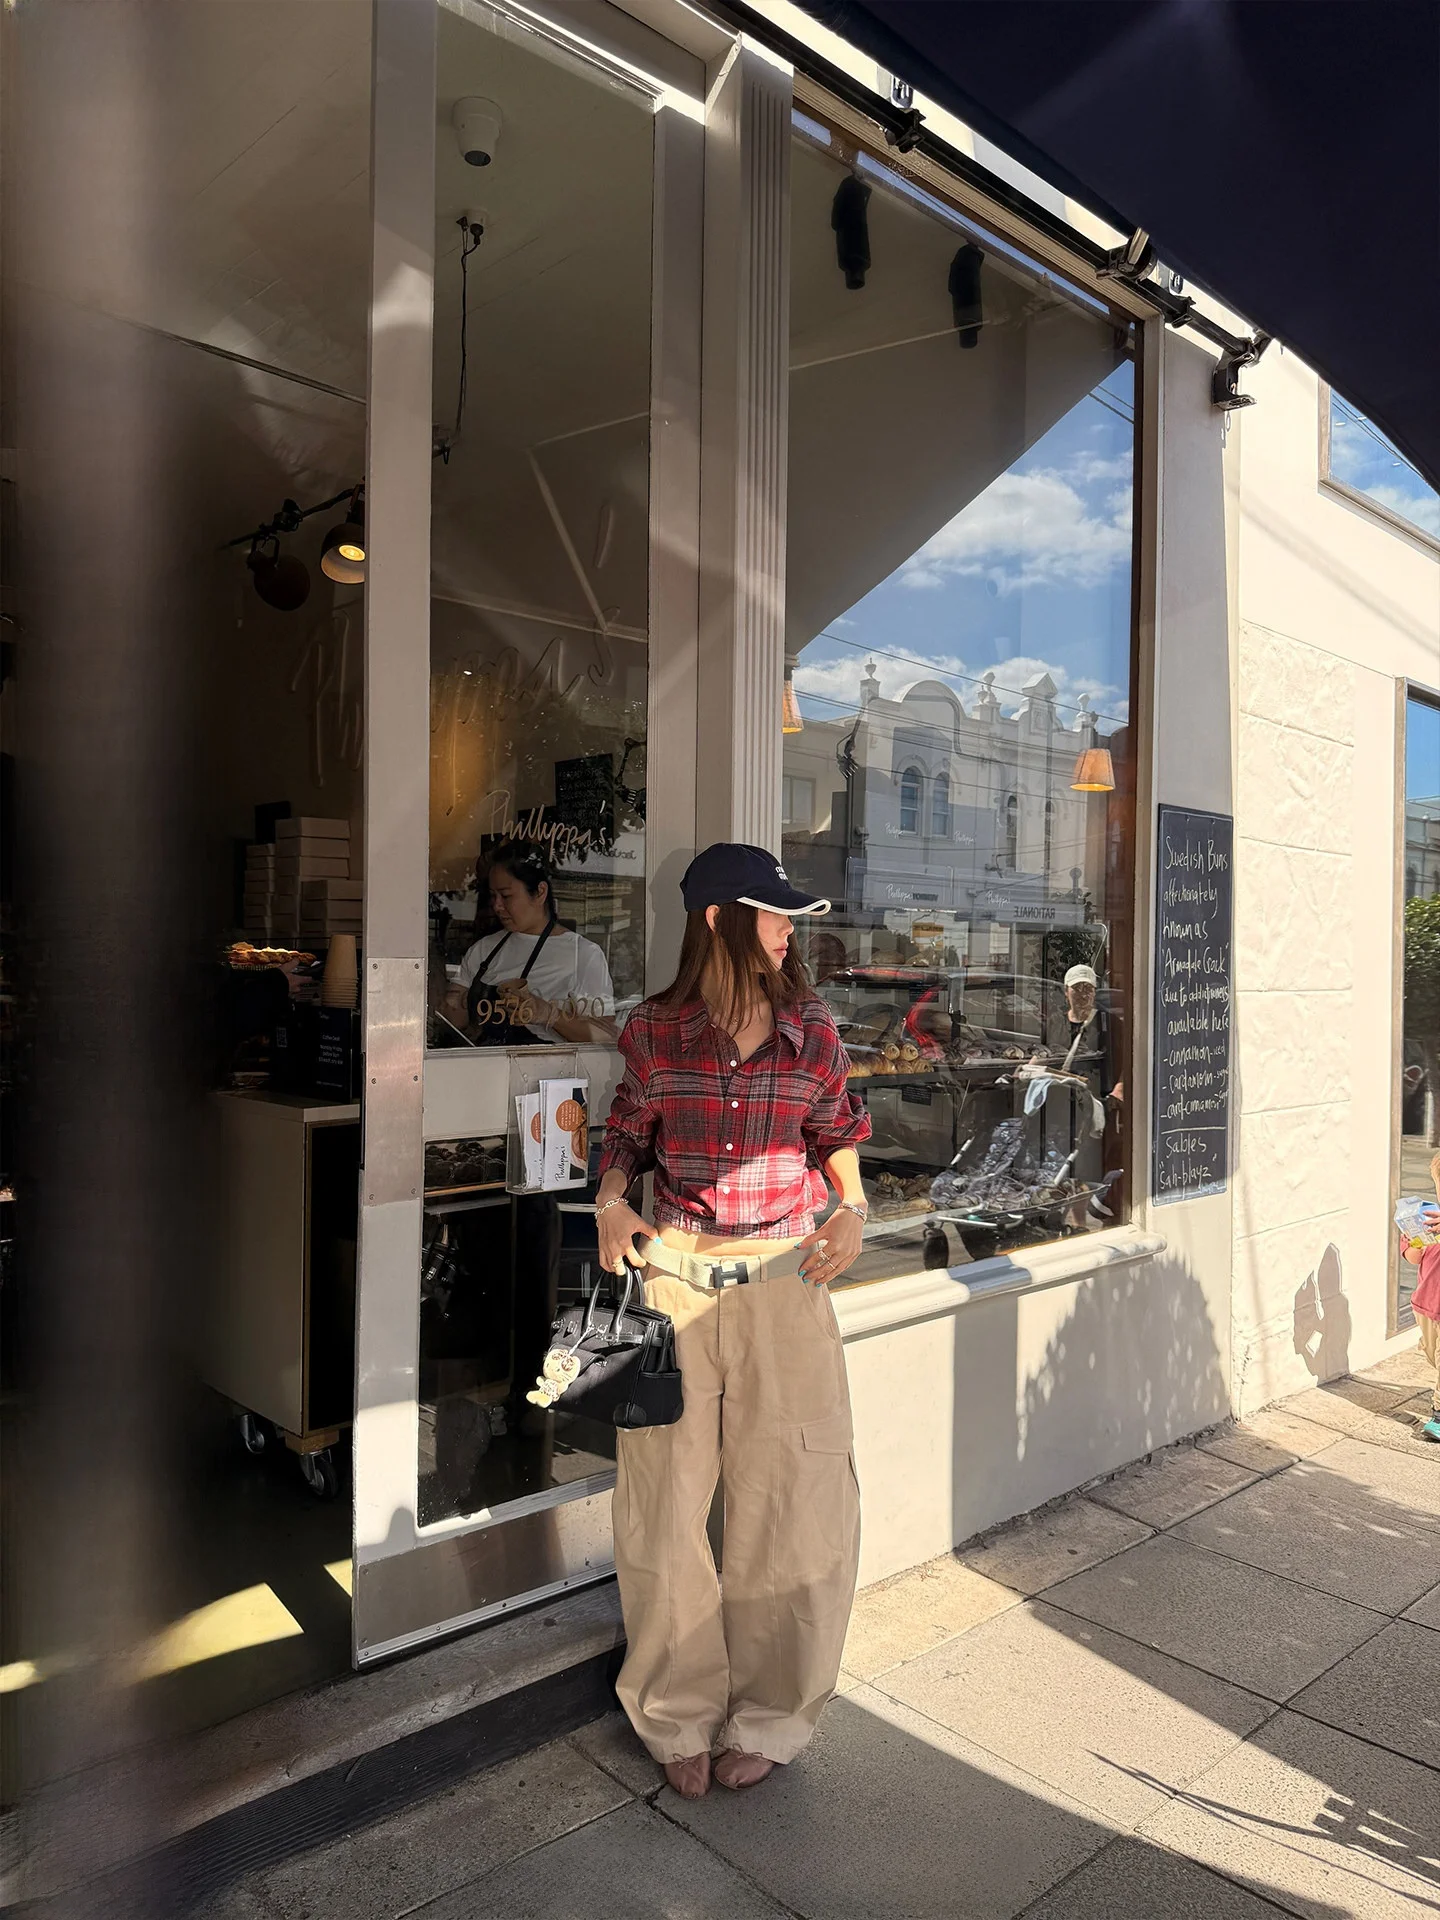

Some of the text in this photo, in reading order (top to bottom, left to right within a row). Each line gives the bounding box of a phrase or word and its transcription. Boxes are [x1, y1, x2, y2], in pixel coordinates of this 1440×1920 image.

[1165, 836, 1229, 875] Swedish Buns
[1163, 877, 1218, 919] affectionately
[1194, 920, 1209, 940] as
[1179, 981, 1188, 1007] to
[476, 997, 535, 1026] 9576
[1168, 1007, 1229, 1036] available here
[1166, 1132, 1207, 1159] Sables
